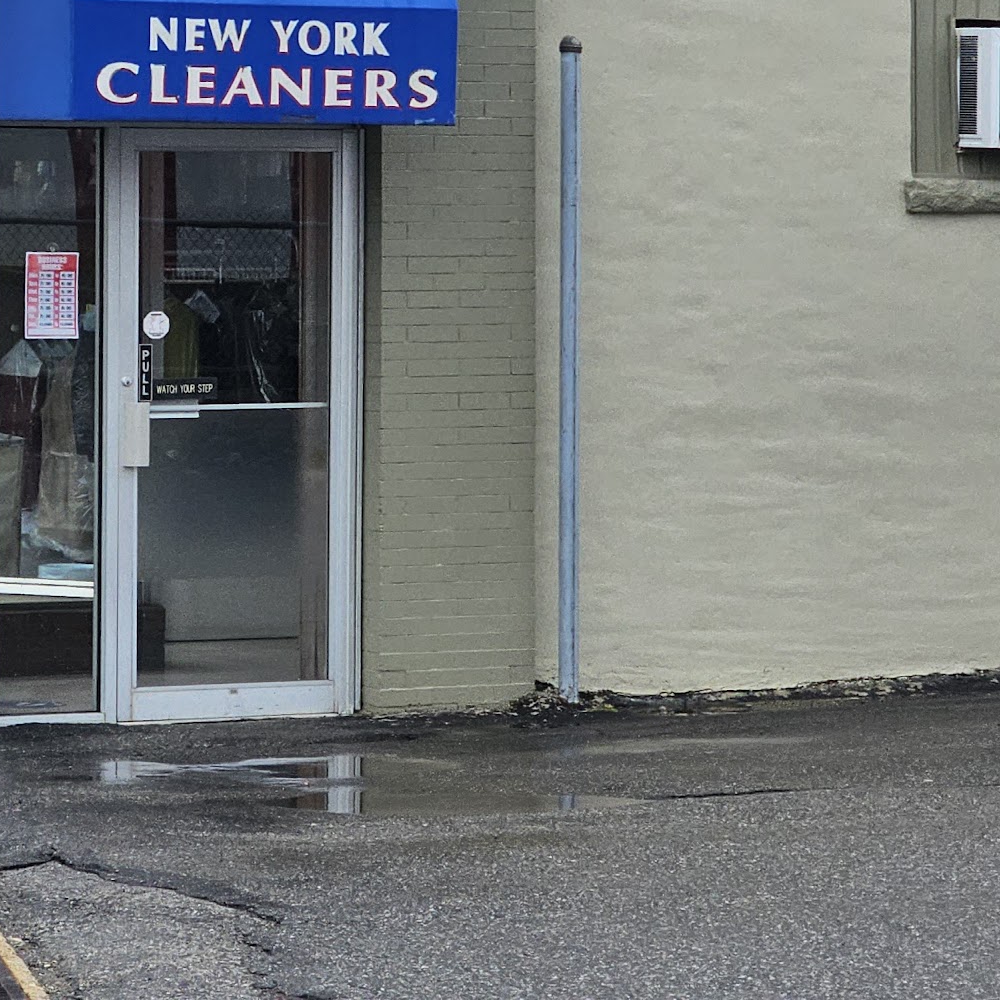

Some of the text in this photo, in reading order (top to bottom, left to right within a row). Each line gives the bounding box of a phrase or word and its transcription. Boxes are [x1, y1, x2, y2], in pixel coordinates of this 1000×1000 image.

[149, 16, 390, 57] NEW YORK
[96, 61, 438, 109] CLEANERS
[142, 349, 150, 396] PULL
[156, 383, 214, 394] WATCH YOUR STEP
